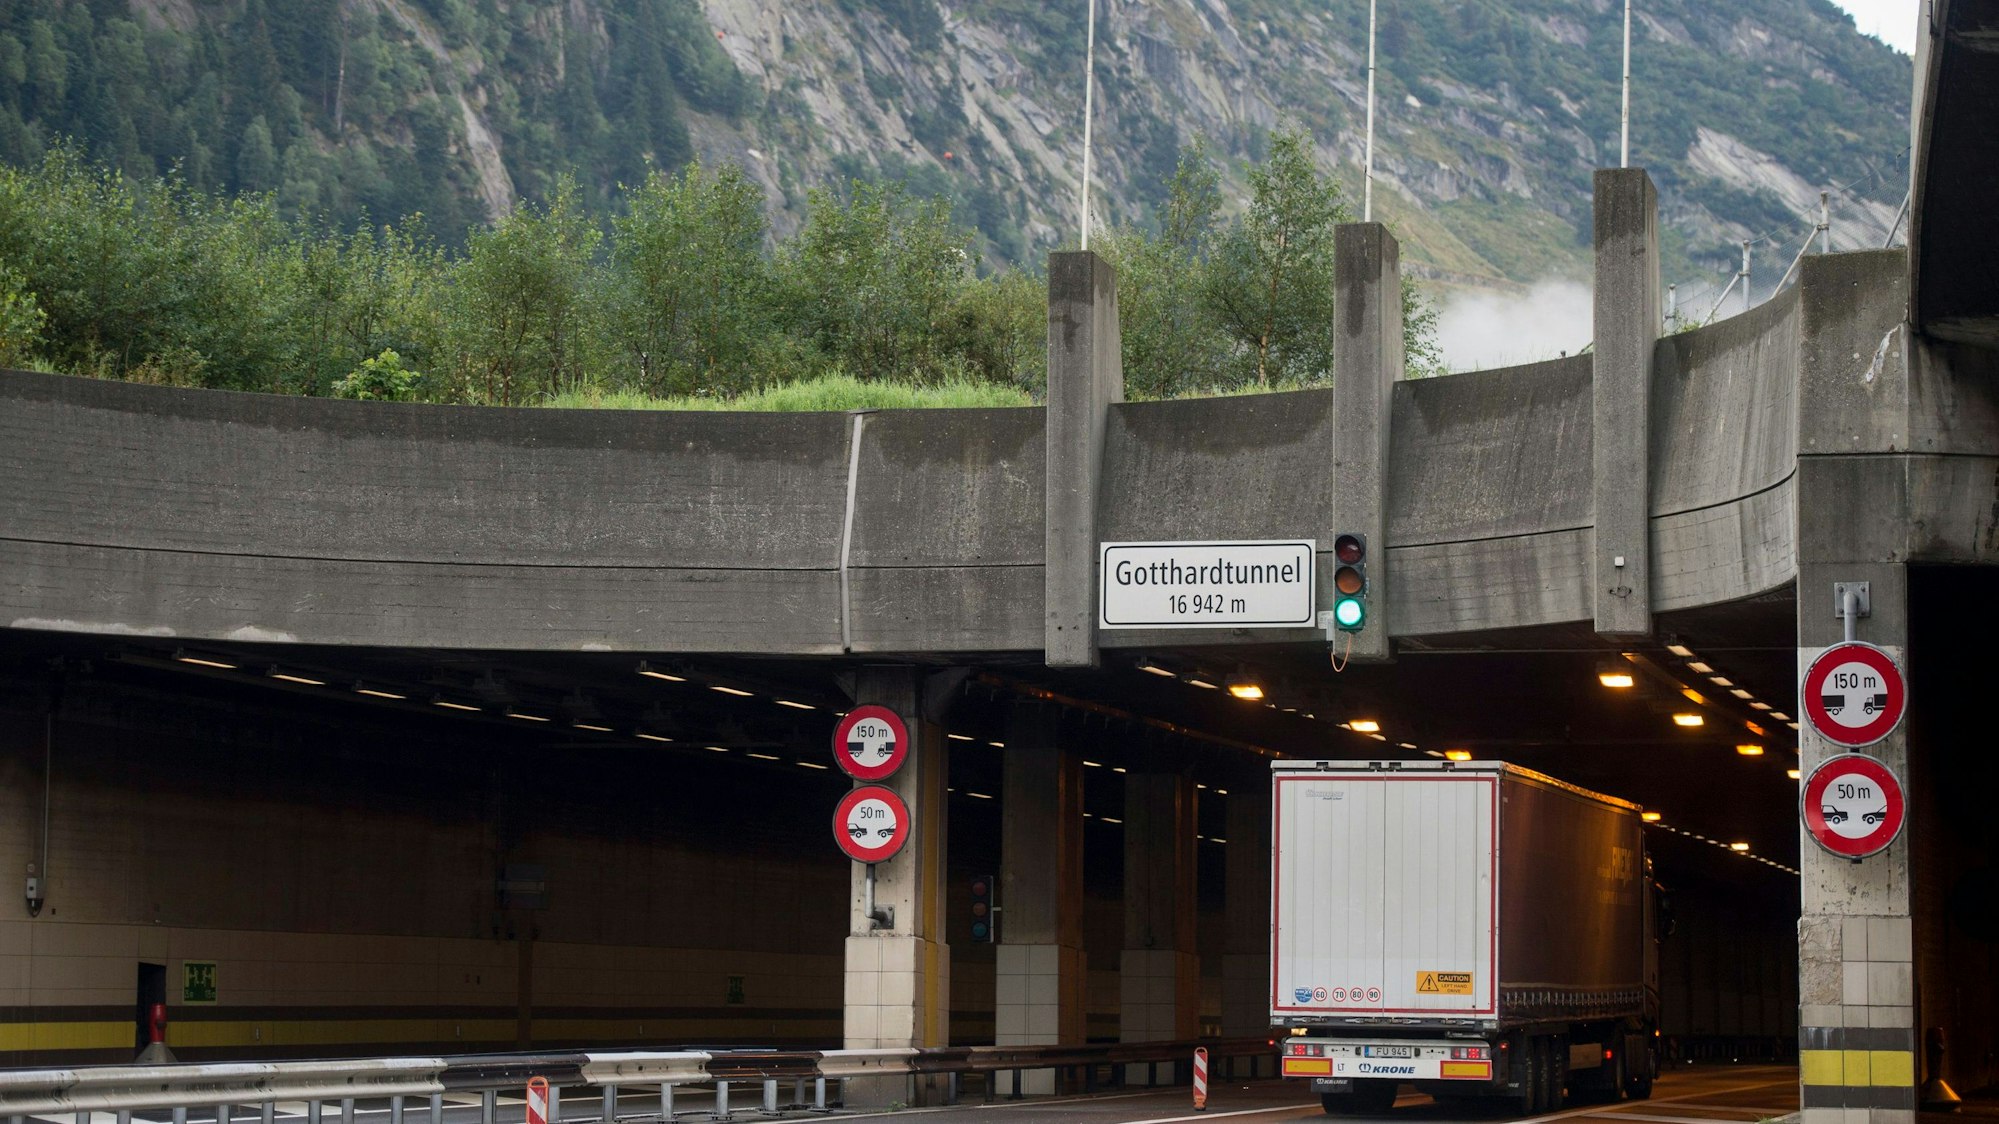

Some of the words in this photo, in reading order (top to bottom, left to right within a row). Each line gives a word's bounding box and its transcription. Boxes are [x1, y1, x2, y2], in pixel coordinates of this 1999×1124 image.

[1115, 556, 1301, 586] Gotthardtunnel
[1169, 595, 1187, 614] 16
[1193, 594, 1224, 614] 942
[1231, 598, 1246, 613] m
[1834, 673, 1858, 689] 150
[1864, 676, 1876, 688] m
[857, 725, 875, 738] 150
[878, 728, 888, 738] m
[1838, 784, 1855, 799] 50
[1858, 787, 1871, 799] m
[860, 806, 873, 819] 50
[875, 809, 885, 819] m
[1438, 974, 1469, 982] CAUTION
[1376, 1047, 1389, 1056] FU
[1391, 1047, 1407, 1056] 945
[1337, 1062, 1345, 1071] LT
[1372, 1065, 1416, 1074] KRONE
